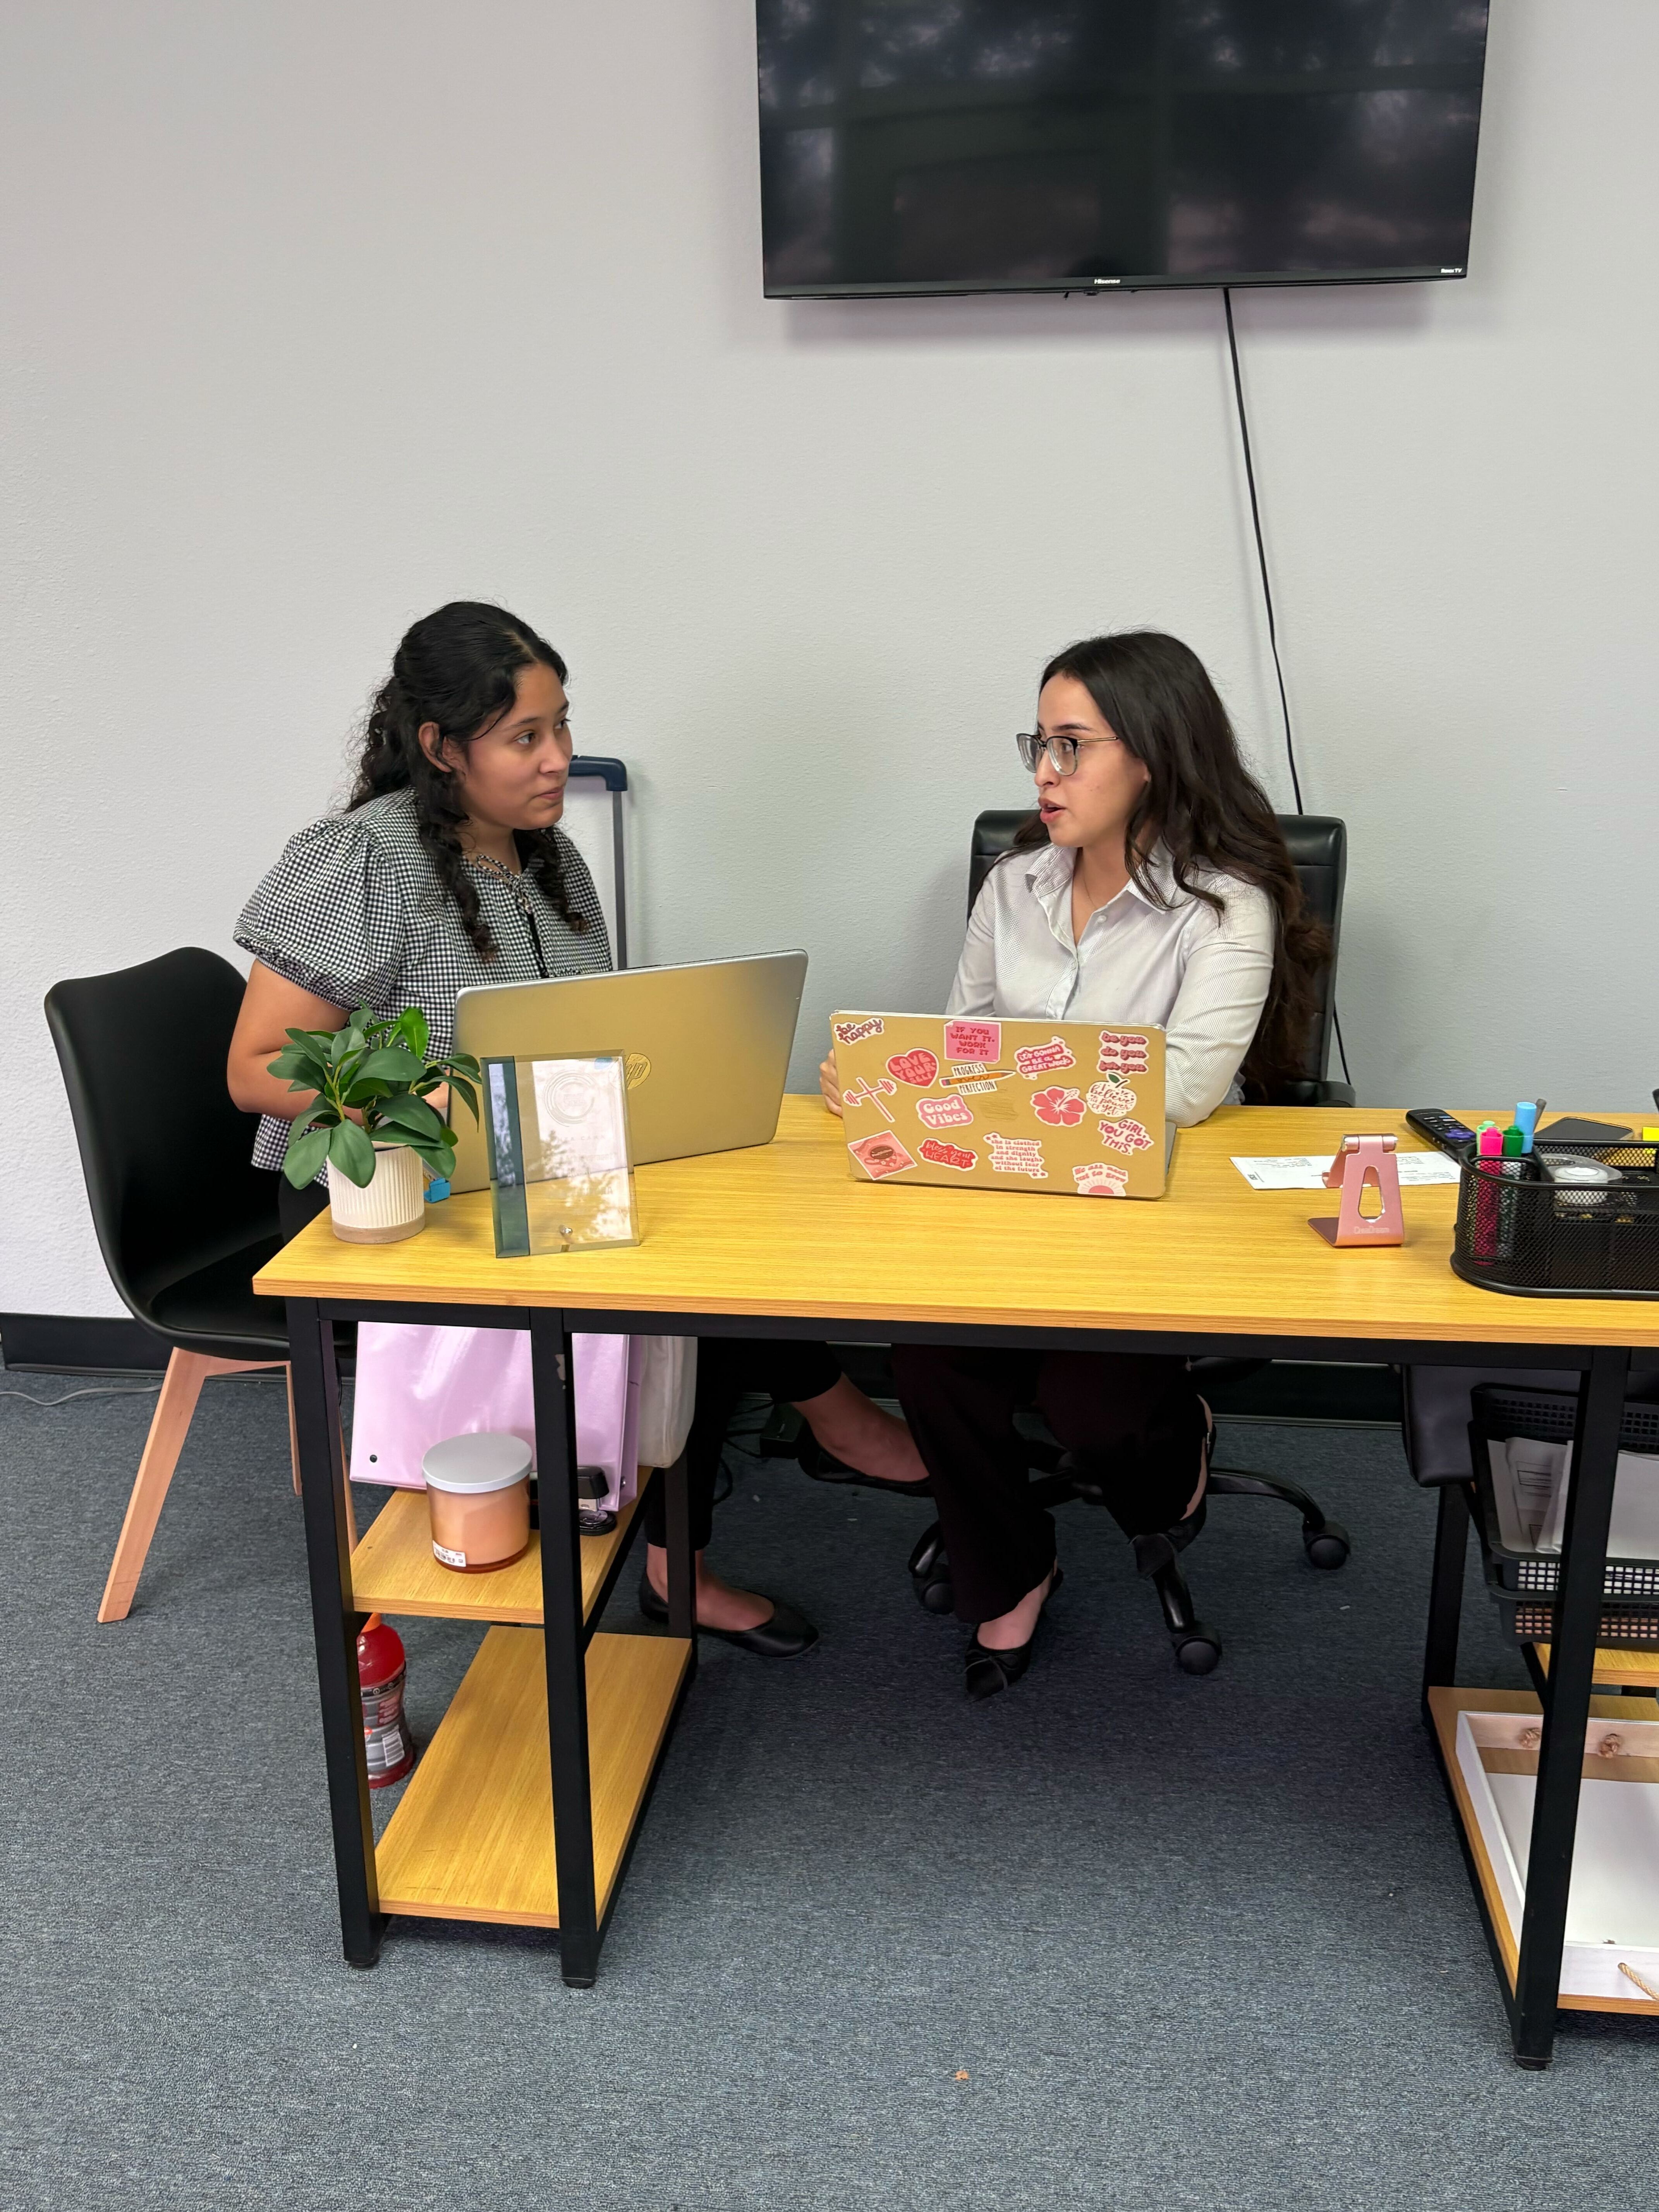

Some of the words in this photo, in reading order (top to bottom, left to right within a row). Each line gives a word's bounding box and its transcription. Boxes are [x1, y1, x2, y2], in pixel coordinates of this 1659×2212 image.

[836, 1024, 855, 1035] be
[838, 1019, 882, 1044] happy
[950, 1033, 978, 1041] WANT
[1101, 1032, 1120, 1043] be
[1120, 1035, 1147, 1047] you
[1033, 1046, 1061, 1057] GONNA
[1101, 1046, 1119, 1057] do
[1120, 1049, 1147, 1061] you
[889, 1053, 931, 1072] LOVE
[1022, 1063, 1047, 1072] GREAT
[1121, 1063, 1147, 1074] you
[953, 1064, 985, 1077] PROGRESS
[910, 1072, 932, 1084] SELF
[958, 1080, 996, 1094] PERFECTION
[1091, 1084, 1134, 1104] believe
[923, 1099, 961, 1114] Good
[925, 1112, 968, 1125] Vibes
[1100, 1122, 1124, 1137] YOU
[1125, 1133, 1151, 1149] GOT
[926, 1151, 969, 1167] HEART
